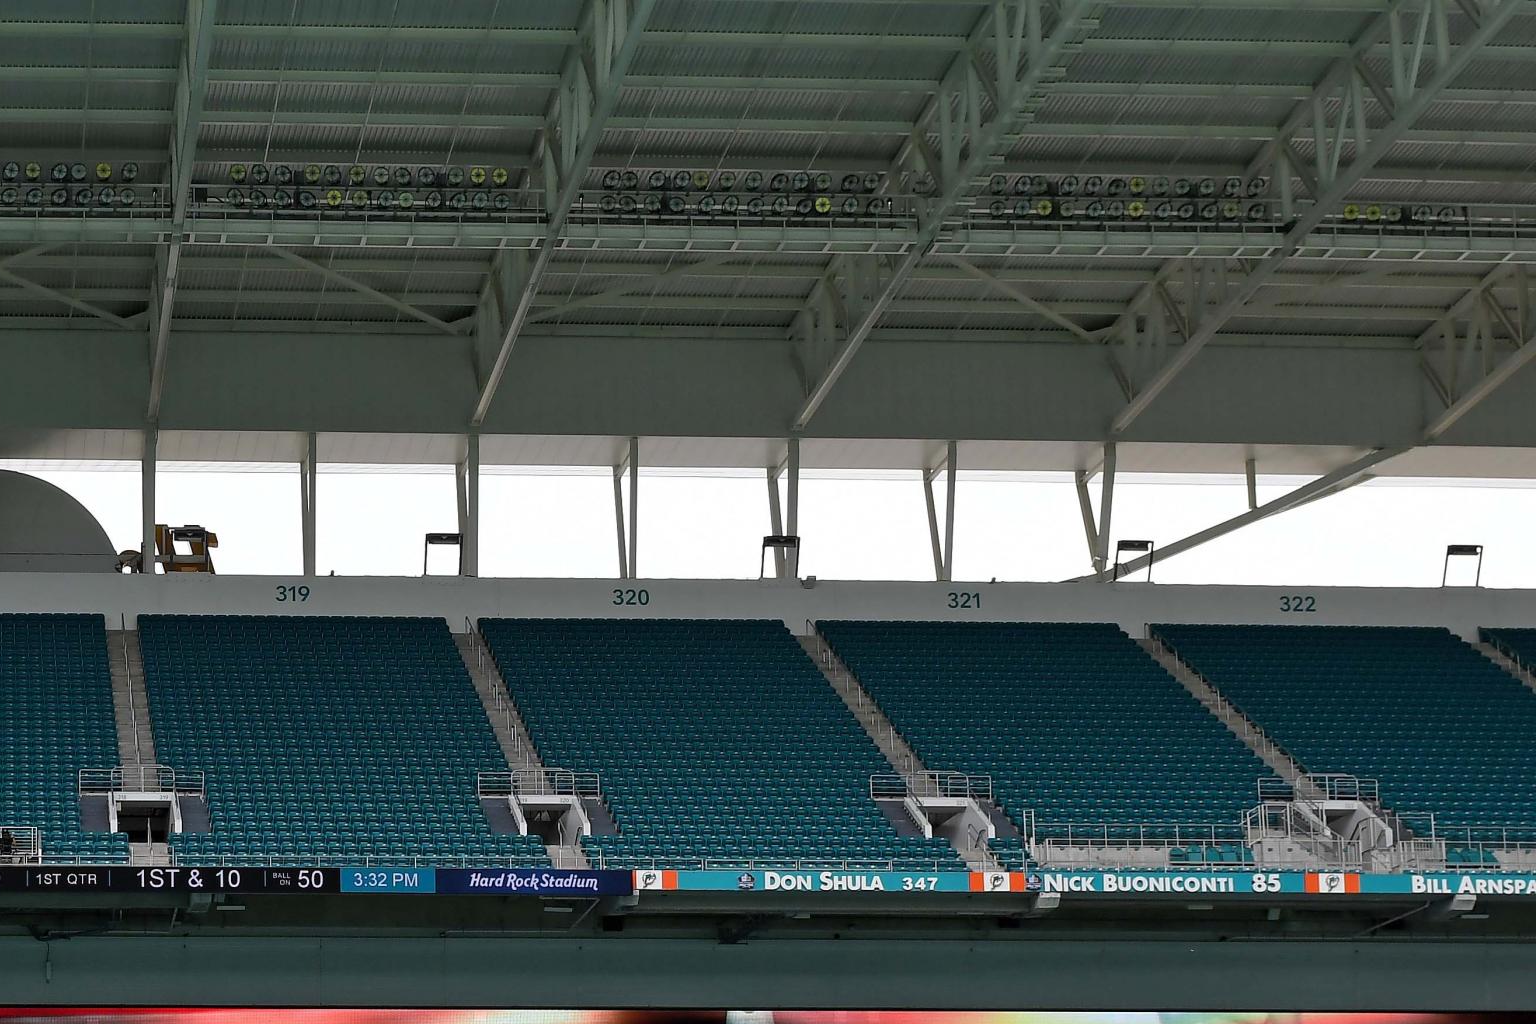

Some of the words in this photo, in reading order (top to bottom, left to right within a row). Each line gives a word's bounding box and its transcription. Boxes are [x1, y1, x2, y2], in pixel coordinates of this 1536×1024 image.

[275, 585, 310, 602] 319
[612, 589, 649, 606] 320
[947, 592, 981, 609] 321
[1280, 596, 1316, 613] 322
[36, 874, 61, 885] 1ST
[67, 873, 97, 886] QTR
[136, 869, 180, 888] 1ST
[188, 869, 204, 888] &
[216, 869, 241, 888] 10
[279, 879, 291, 887] ON
[297, 870, 324, 888] 50
[354, 872, 388, 888] 3:32
[392, 872, 418, 888] PM
[469, 872, 507, 888] Hard
[506, 873, 540, 892] Rock
[540, 873, 599, 892] Stadium
[902, 877, 938, 890] 347
[1252, 874, 1281, 893] 85
